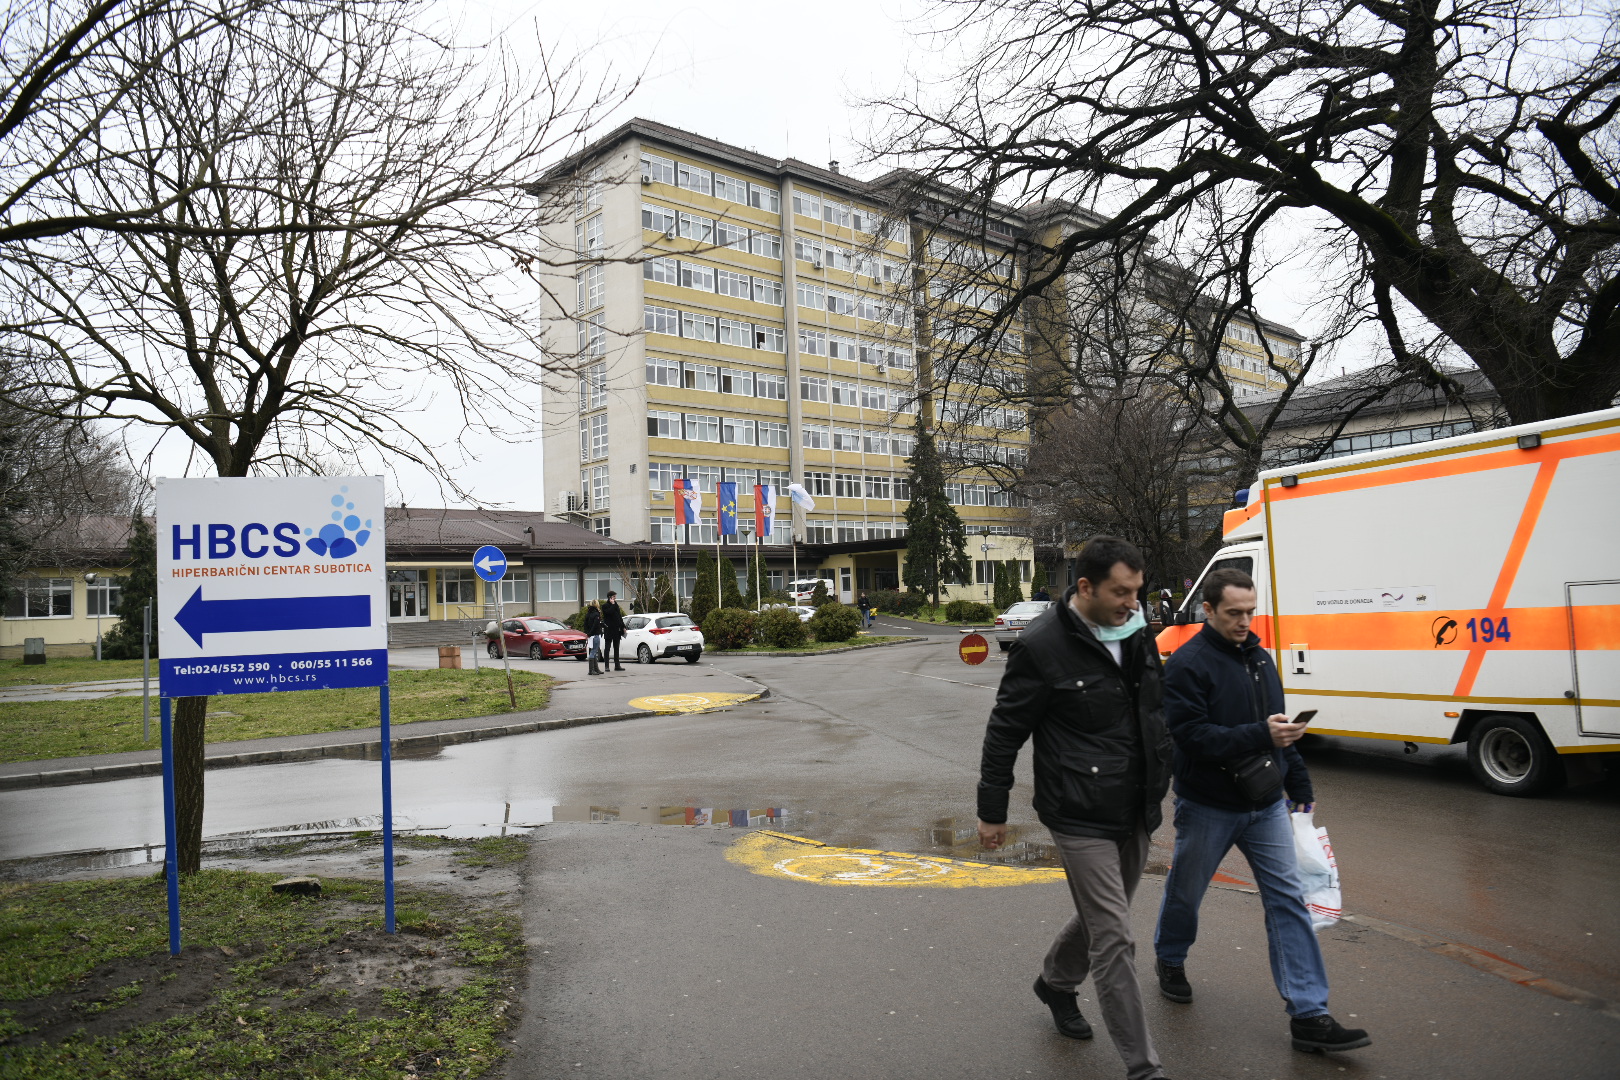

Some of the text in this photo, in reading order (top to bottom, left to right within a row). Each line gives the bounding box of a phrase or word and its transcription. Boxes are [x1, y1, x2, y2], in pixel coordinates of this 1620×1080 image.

[172, 522, 301, 560] HBCS
[172, 563, 372, 578] HIPERBARIČNI CENTAR SUBOTICA
[1466, 617, 1511, 643] 194
[173, 657, 373, 675] Tel:024/552 590 060/55 11 566
[233, 674, 317, 685] www.hbcs.rs
